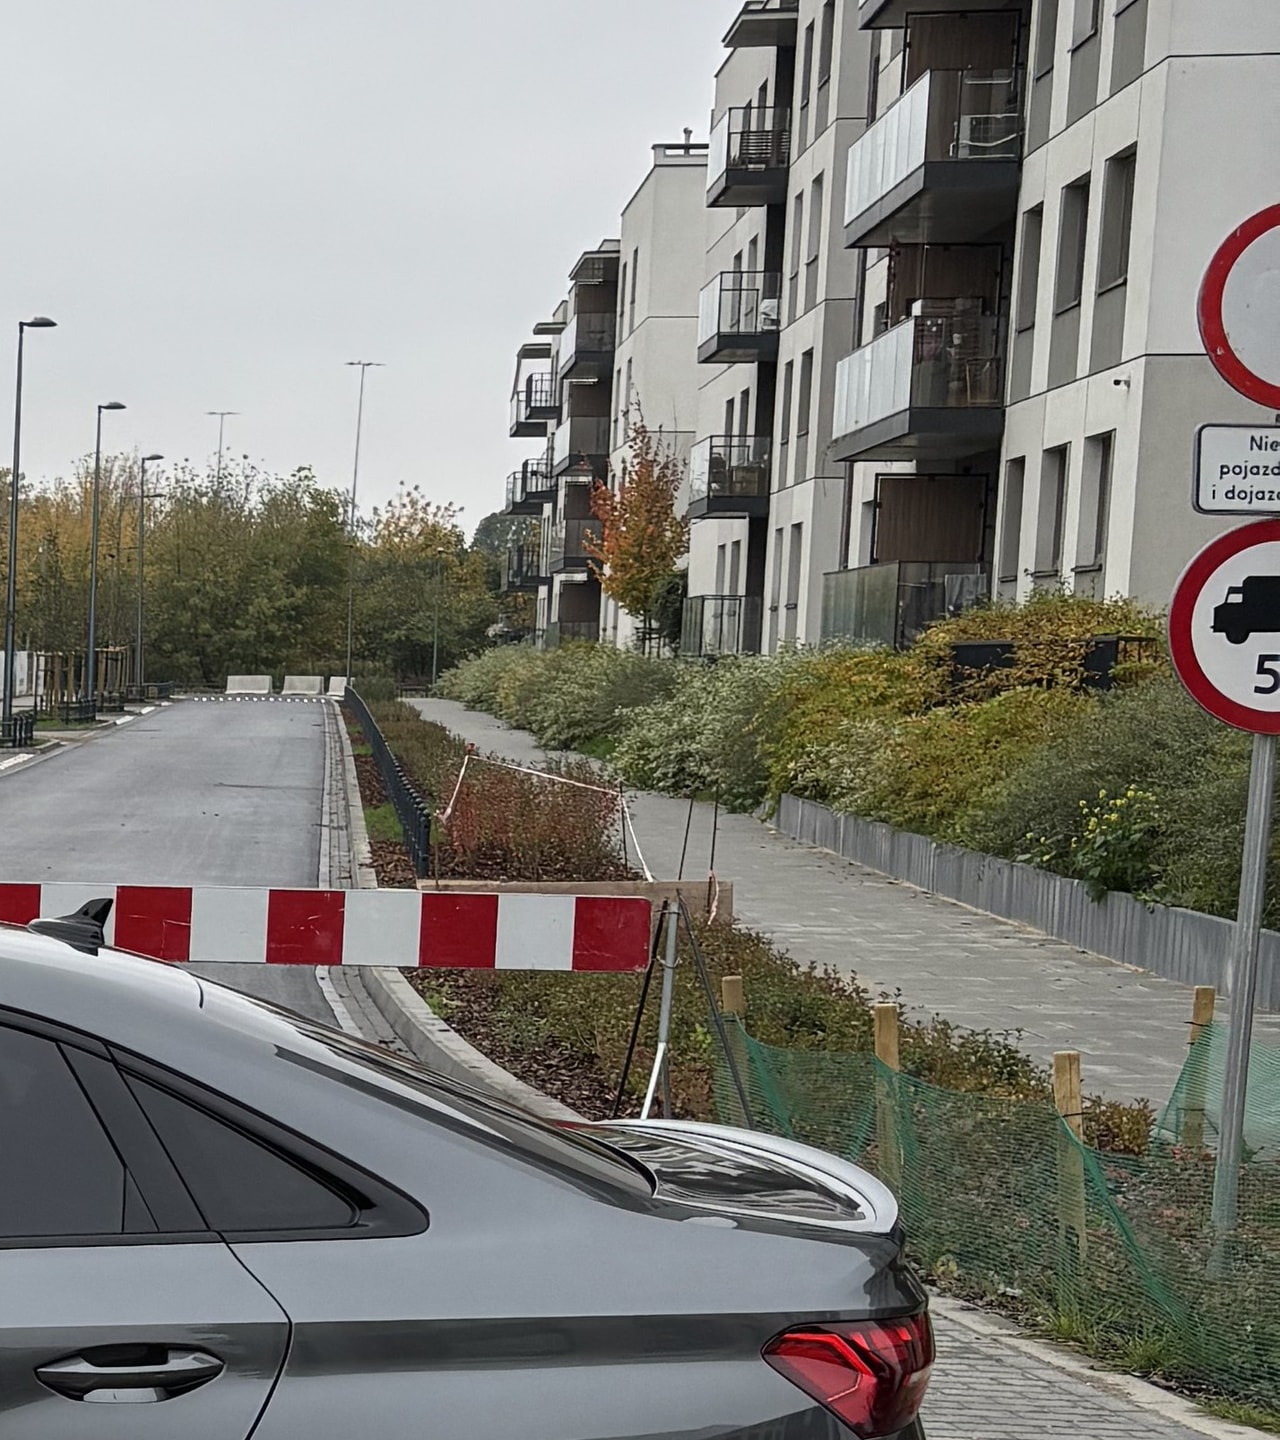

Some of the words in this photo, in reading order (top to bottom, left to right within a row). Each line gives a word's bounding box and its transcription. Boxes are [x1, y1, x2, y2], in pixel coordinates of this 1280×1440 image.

[1250, 434, 1280, 452] Nie
[1212, 484, 1216, 500] i
[1253, 654, 1280, 695] 5
